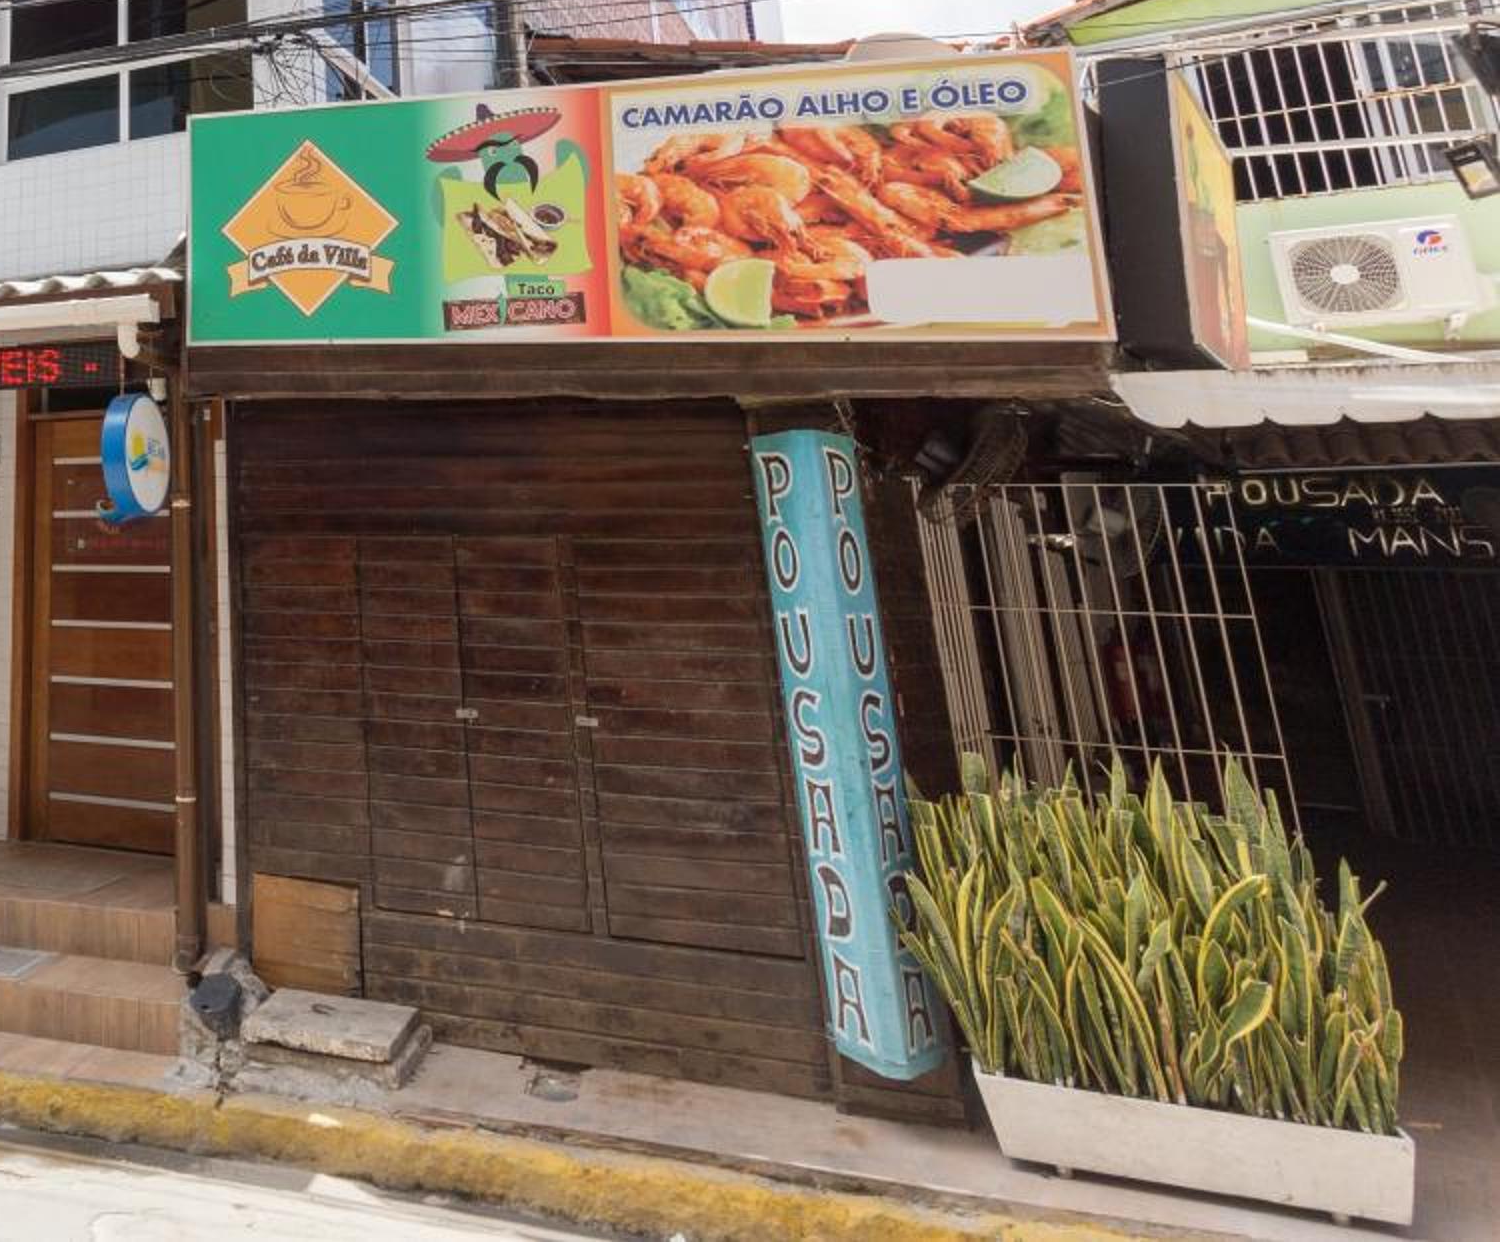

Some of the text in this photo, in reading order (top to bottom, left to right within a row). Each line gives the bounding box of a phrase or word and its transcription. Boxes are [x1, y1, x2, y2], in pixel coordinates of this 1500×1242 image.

[621, 79, 1028, 129] CAMARÃO ALHO E ÓLEO
[251, 246, 295, 272] Café
[518, 283, 555, 295] Taco
[1205, 477, 1445, 508] POUSADA
[756, 446, 877, 1049] POUSADA
